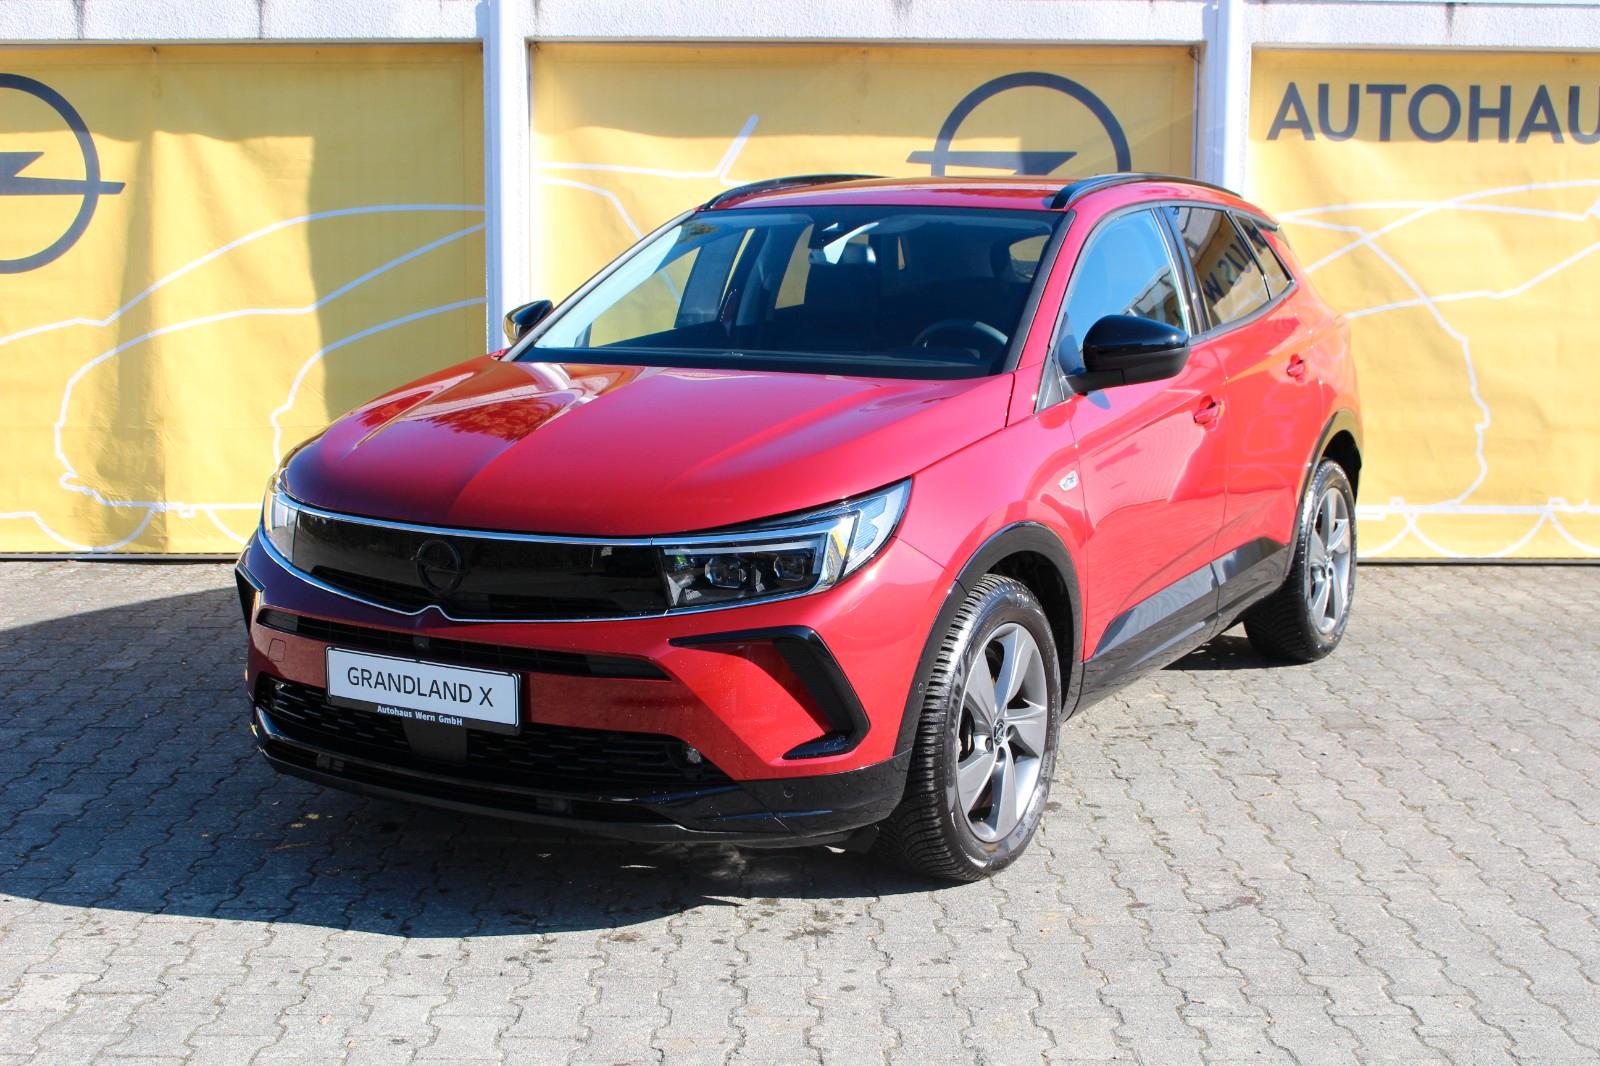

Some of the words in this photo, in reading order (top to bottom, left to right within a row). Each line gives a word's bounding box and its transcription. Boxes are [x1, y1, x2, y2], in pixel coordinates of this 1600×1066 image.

[1266, 81, 1600, 145] AUTOHAU
[347, 666, 473, 704] GRANDLAND
[479, 686, 494, 707] X
[377, 705, 412, 718] Autohaus
[415, 711, 435, 721] Wern
[438, 715, 463, 726] GmbH
